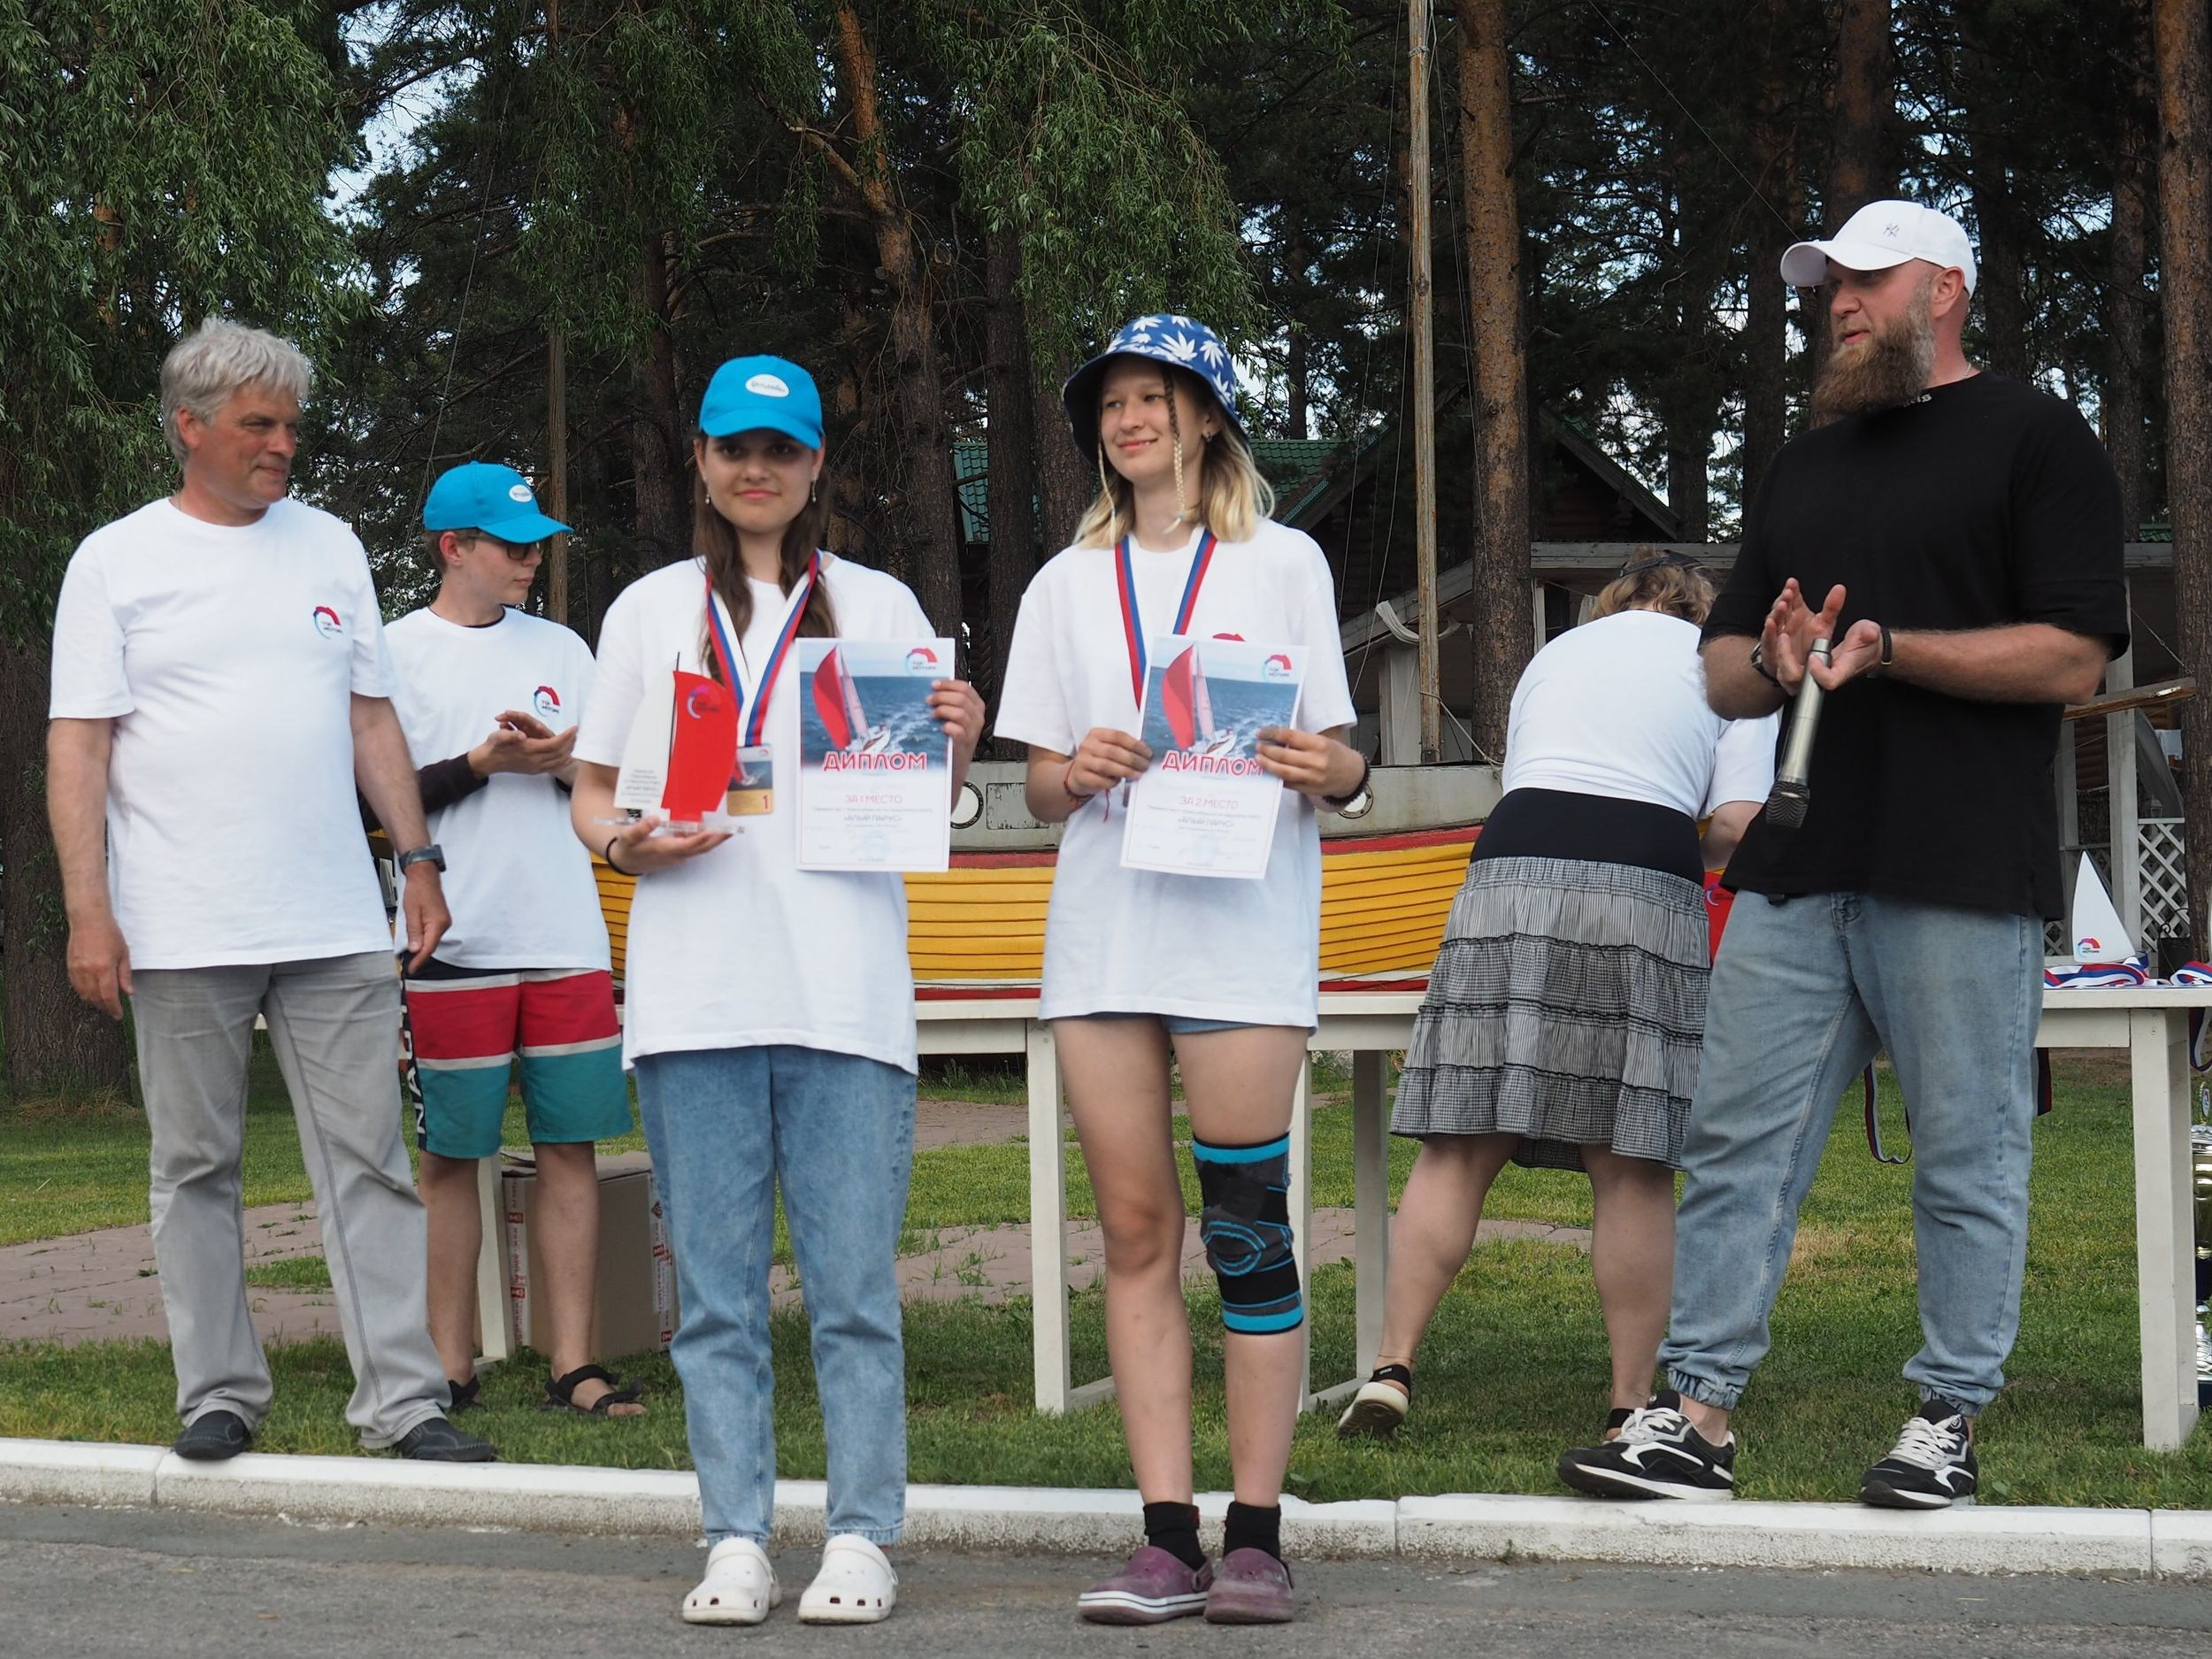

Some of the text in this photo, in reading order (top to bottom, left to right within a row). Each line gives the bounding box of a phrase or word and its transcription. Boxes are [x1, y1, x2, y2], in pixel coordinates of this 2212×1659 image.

[823, 752, 927, 772] ДИПЛОМ
[1162, 752, 1265, 776] ДИПЛОМ
[762, 795, 769, 810] 1
[845, 795, 858, 804] ЗА
[865, 795, 902, 804] МЕСТО
[1179, 795, 1194, 805] ЗА
[1203, 799, 1239, 810] МЕСТО
